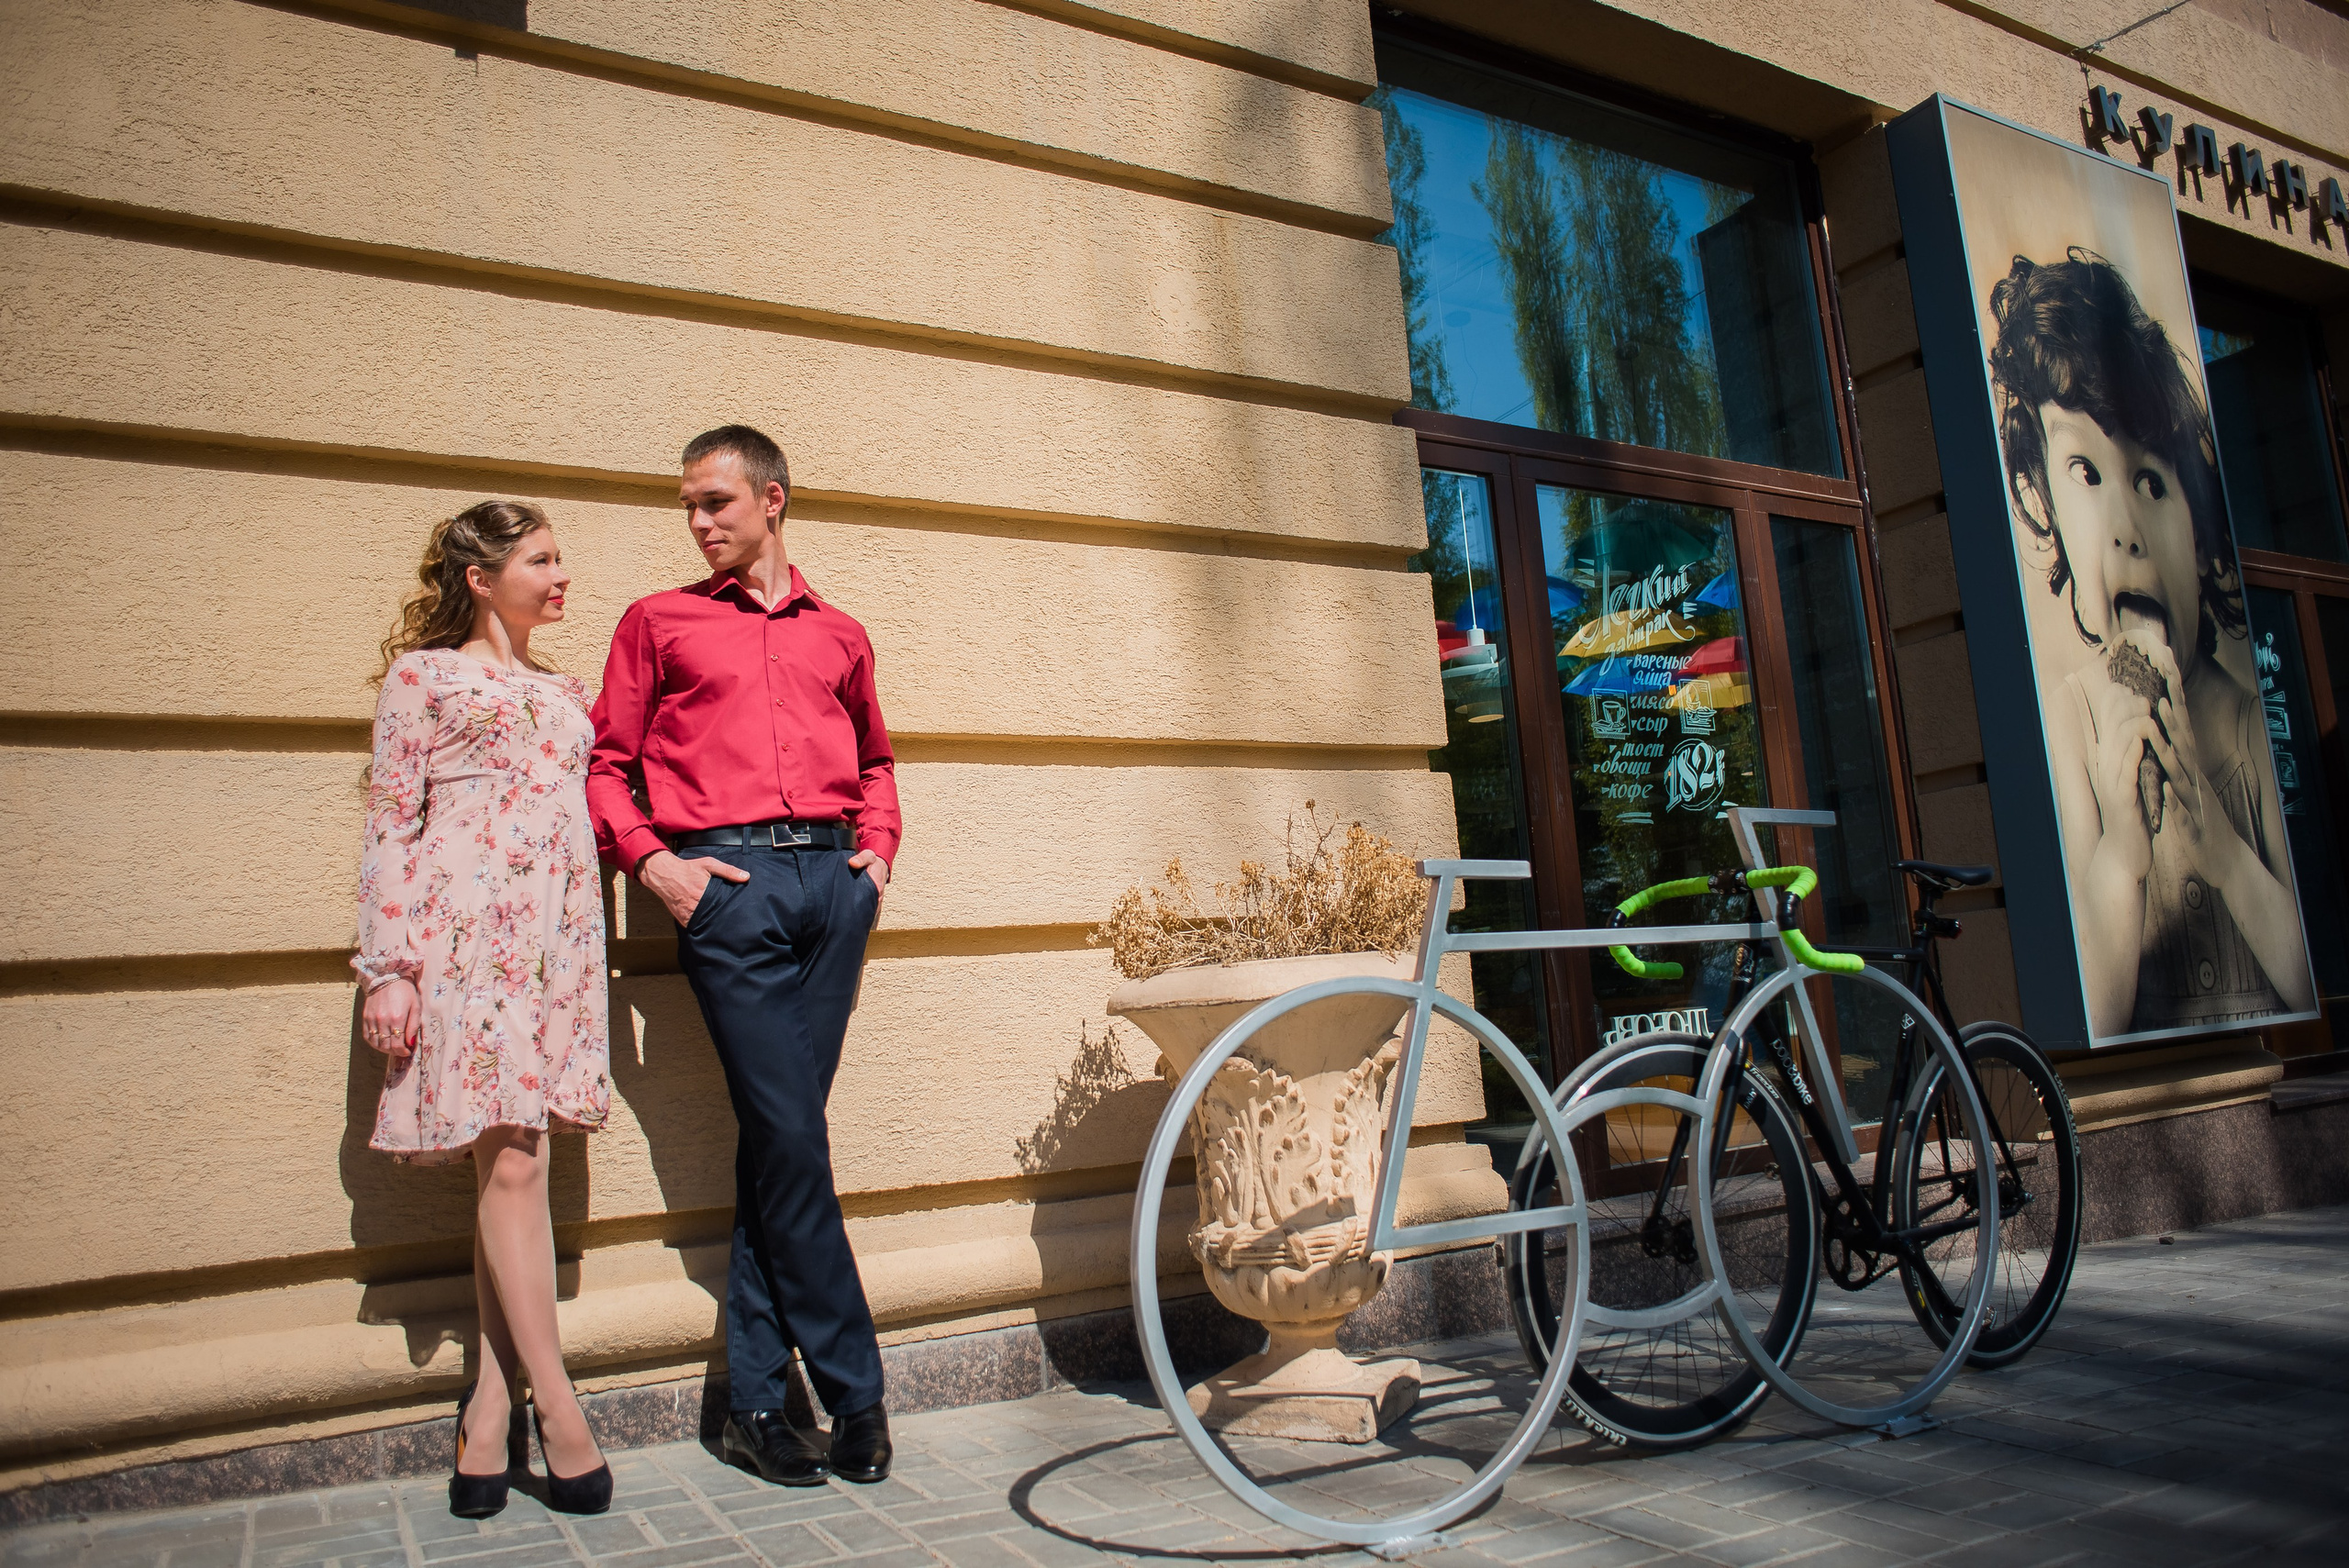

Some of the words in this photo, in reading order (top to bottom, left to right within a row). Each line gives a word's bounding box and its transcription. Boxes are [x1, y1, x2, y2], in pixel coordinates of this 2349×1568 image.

[1631, 695, 1674, 710] мясо
[1637, 717, 1668, 736] сыр
[1621, 742, 1664, 757] тост
[1600, 751, 1652, 779] овощи
[1608, 783, 1653, 803] кофе
